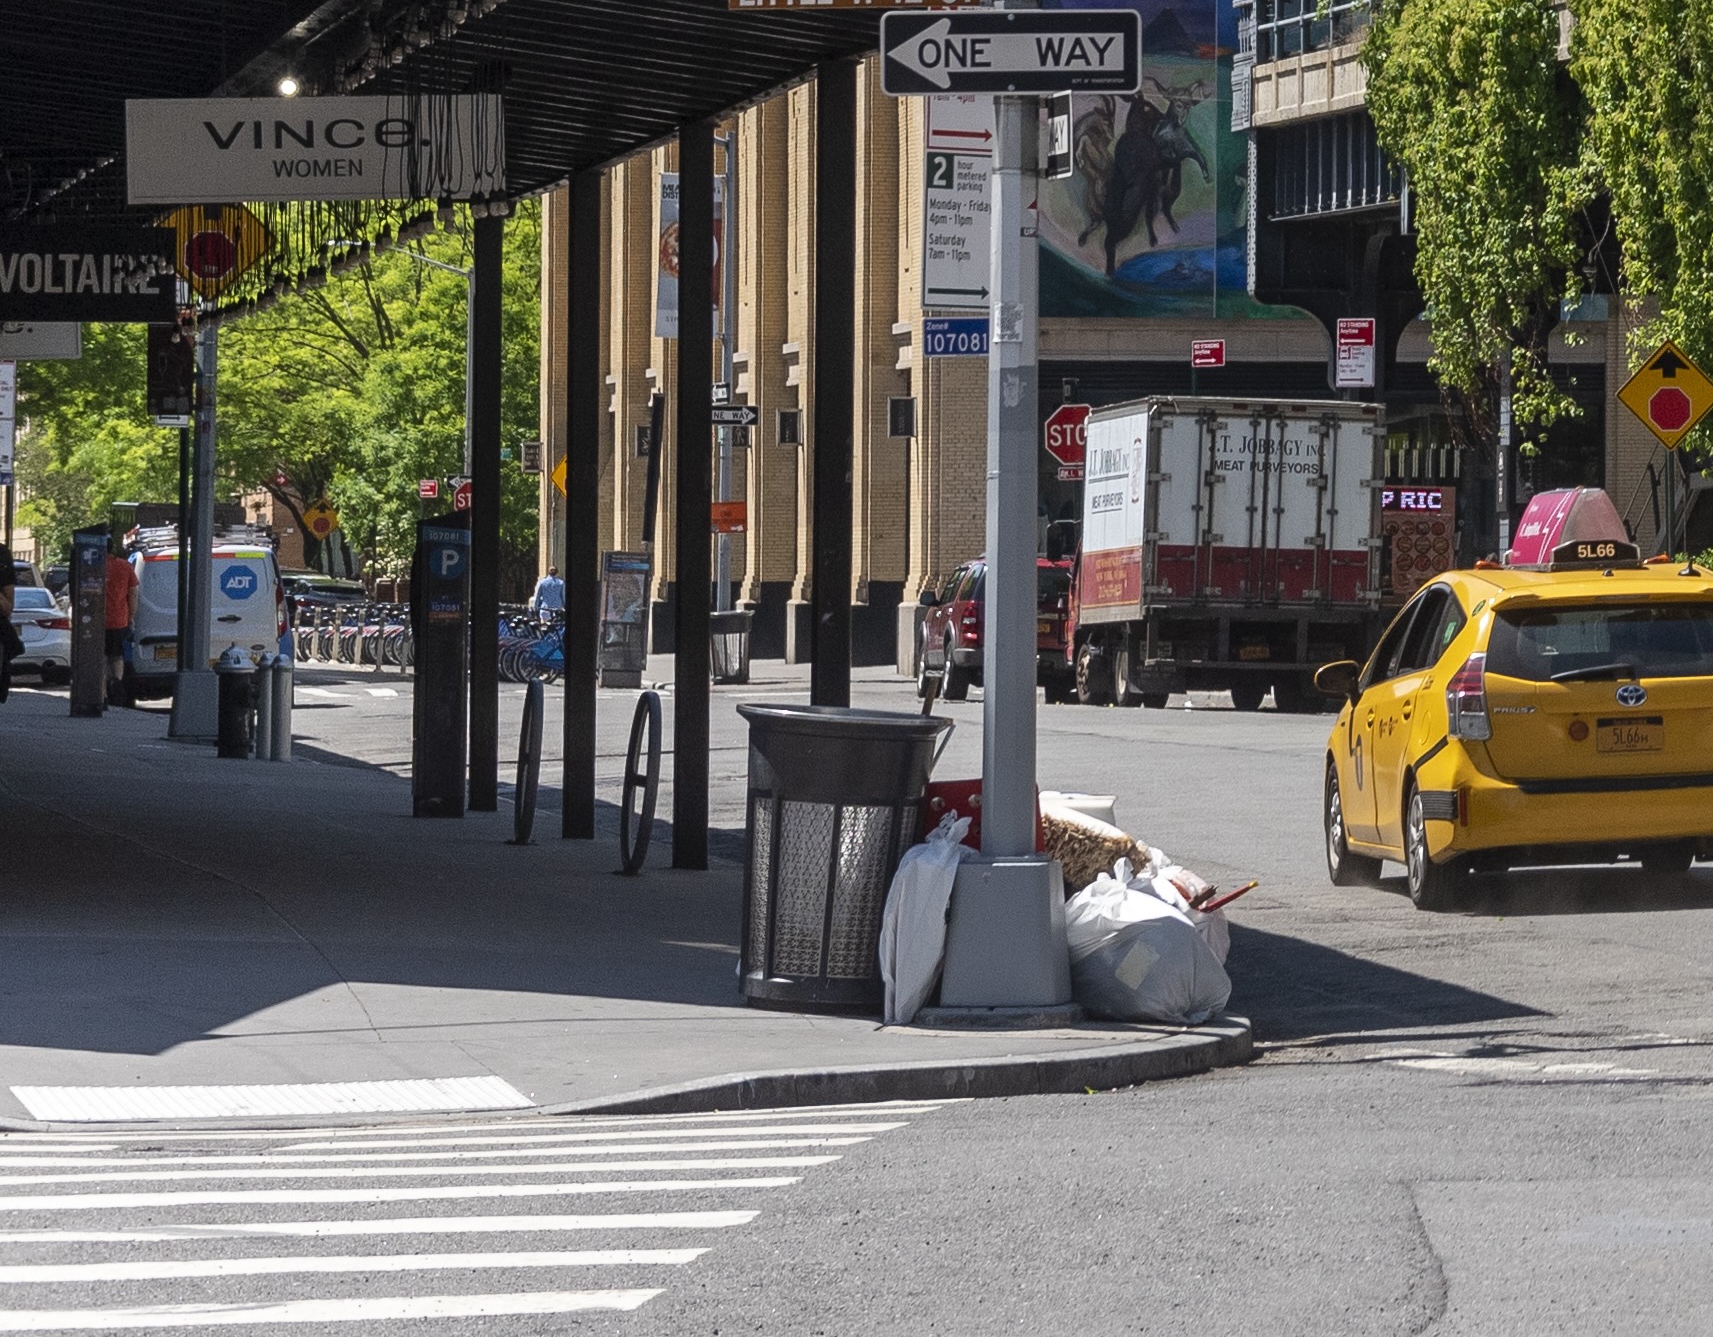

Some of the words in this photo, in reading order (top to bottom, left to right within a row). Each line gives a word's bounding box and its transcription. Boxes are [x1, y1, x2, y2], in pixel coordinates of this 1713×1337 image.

[918, 38, 992, 69] ONE
[1035, 36, 1116, 68] WAY
[273, 158, 364, 179] WOMEN
[933, 155, 948, 187] 2
[957, 160, 975, 172] hour
[957, 171, 987, 182] metered
[957, 182, 983, 194] parking
[929, 198, 962, 213] Monday
[969, 199, 992, 215] Friday
[929, 212, 948, 226] 4pm
[954, 213, 973, 227] 11pm
[929, 233, 966, 248] Saturday
[929, 247, 945, 260] 7am
[951, 247, 971, 262] 11pm
[926, 321, 949, 330] Zone#
[926, 333, 988, 352] 107081
[1050, 424, 1086, 447] STO
[1238, 435, 1303, 456] JOBBAGY
[1213, 460, 1245, 472] MEAT
[1249, 461, 1319, 475] PURVEYORS
[1400, 491, 1442, 509] RIC
[1577, 543, 1616, 558] 5L66
[441, 549, 460, 575] P
[225, 575, 252, 590] ADT
